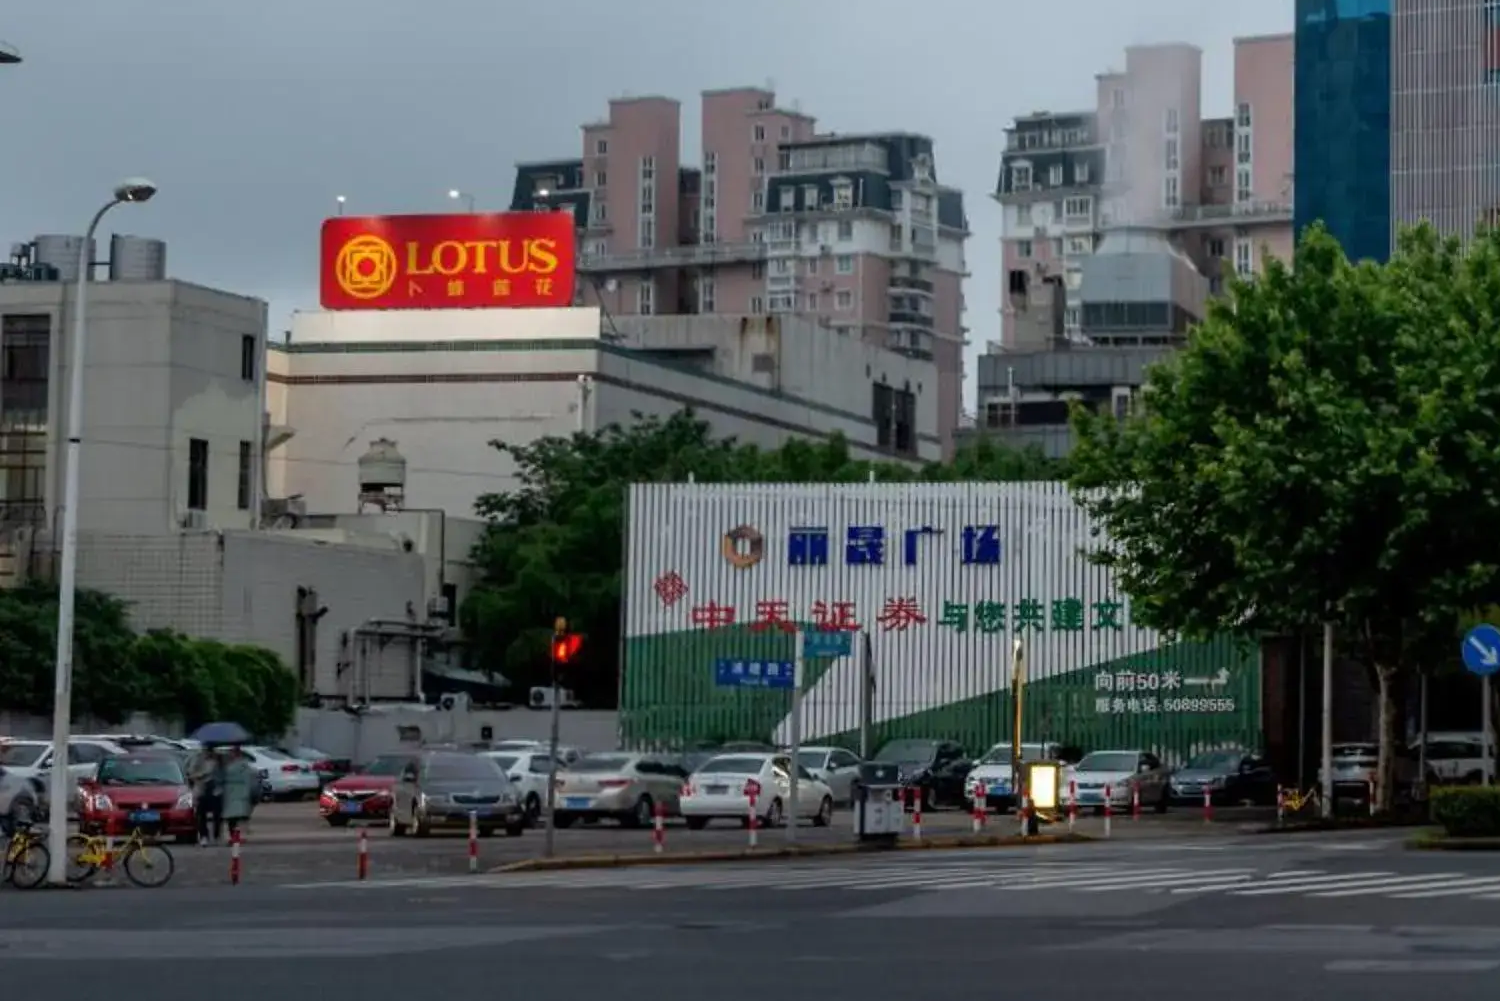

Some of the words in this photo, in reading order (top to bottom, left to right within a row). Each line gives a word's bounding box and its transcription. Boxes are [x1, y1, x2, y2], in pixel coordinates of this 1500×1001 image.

[405, 238, 558, 275] LOTUS
[690, 596, 926, 632] 中天证券
